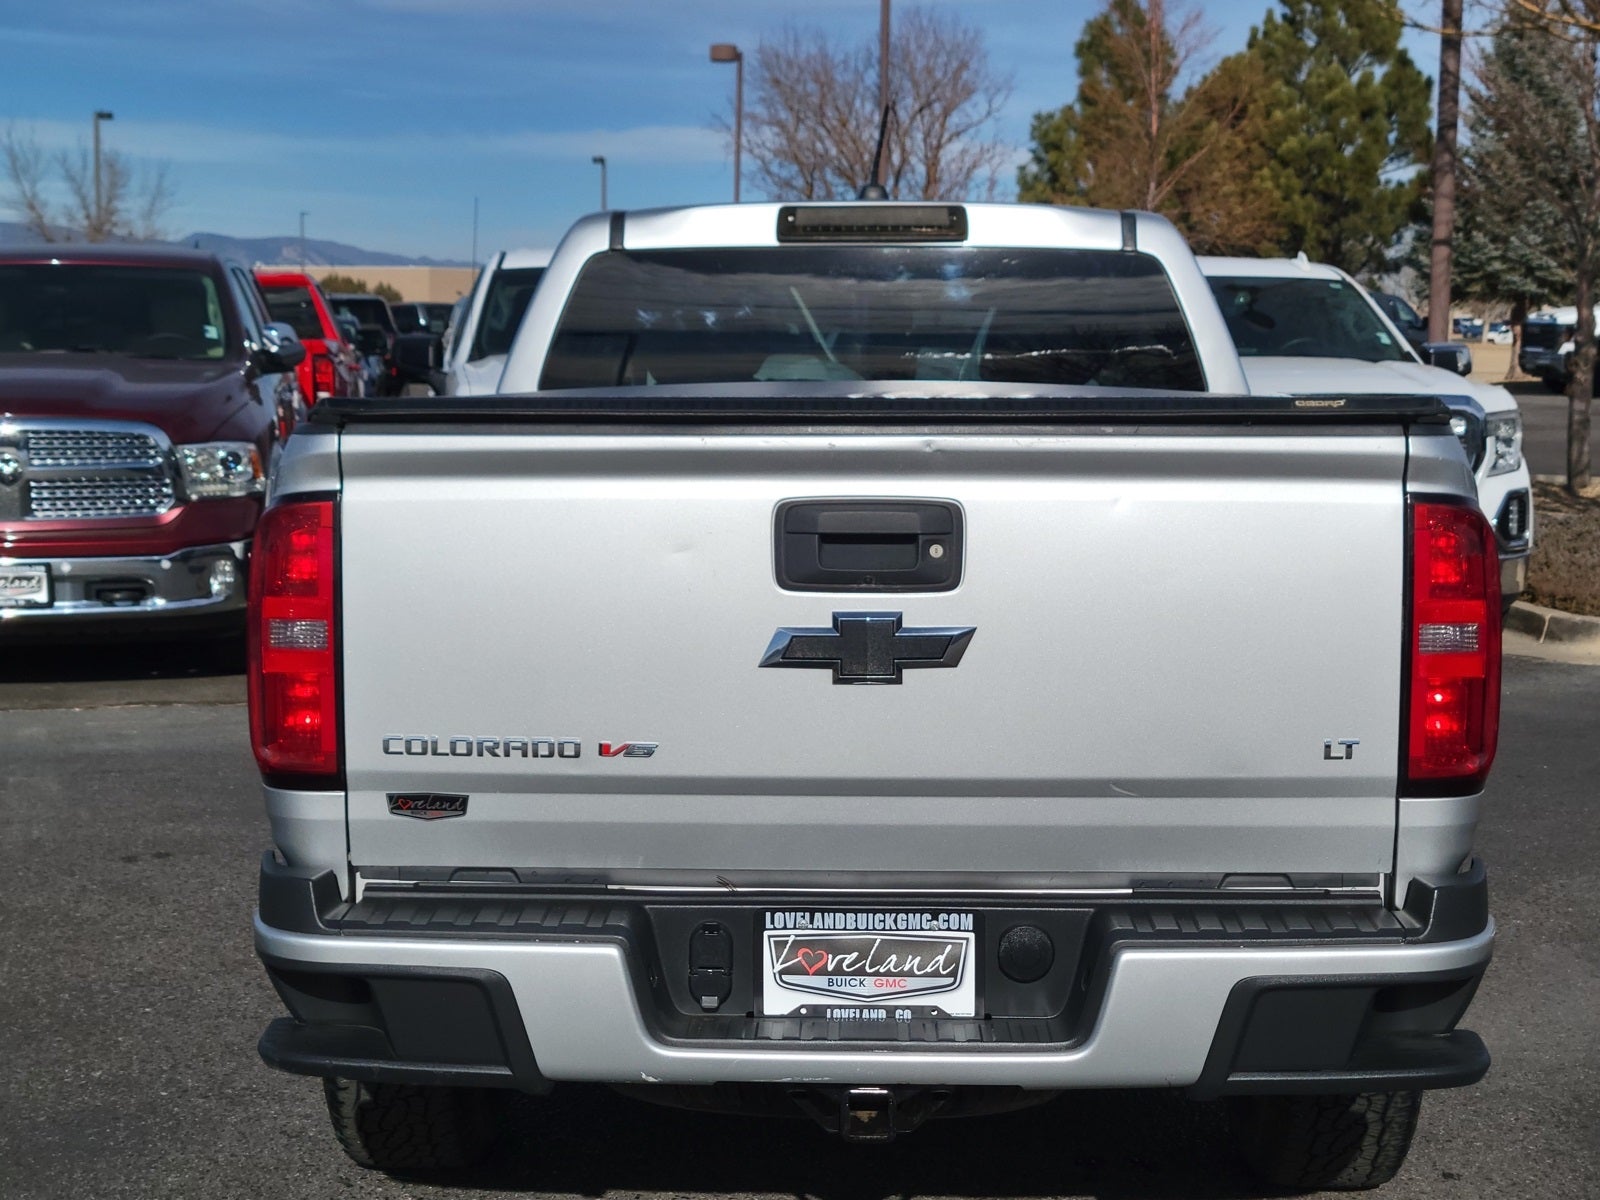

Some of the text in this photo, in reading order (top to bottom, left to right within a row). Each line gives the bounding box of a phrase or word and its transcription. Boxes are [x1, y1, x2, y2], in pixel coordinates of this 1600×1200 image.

[382, 734, 659, 758] COLORADO V6
[1324, 738, 1360, 760] LT
[765, 911, 973, 930] LOVELANDBUICKGMCCOM
[827, 977, 907, 989] BUICK GMC
[895, 1009, 912, 1021] CO
